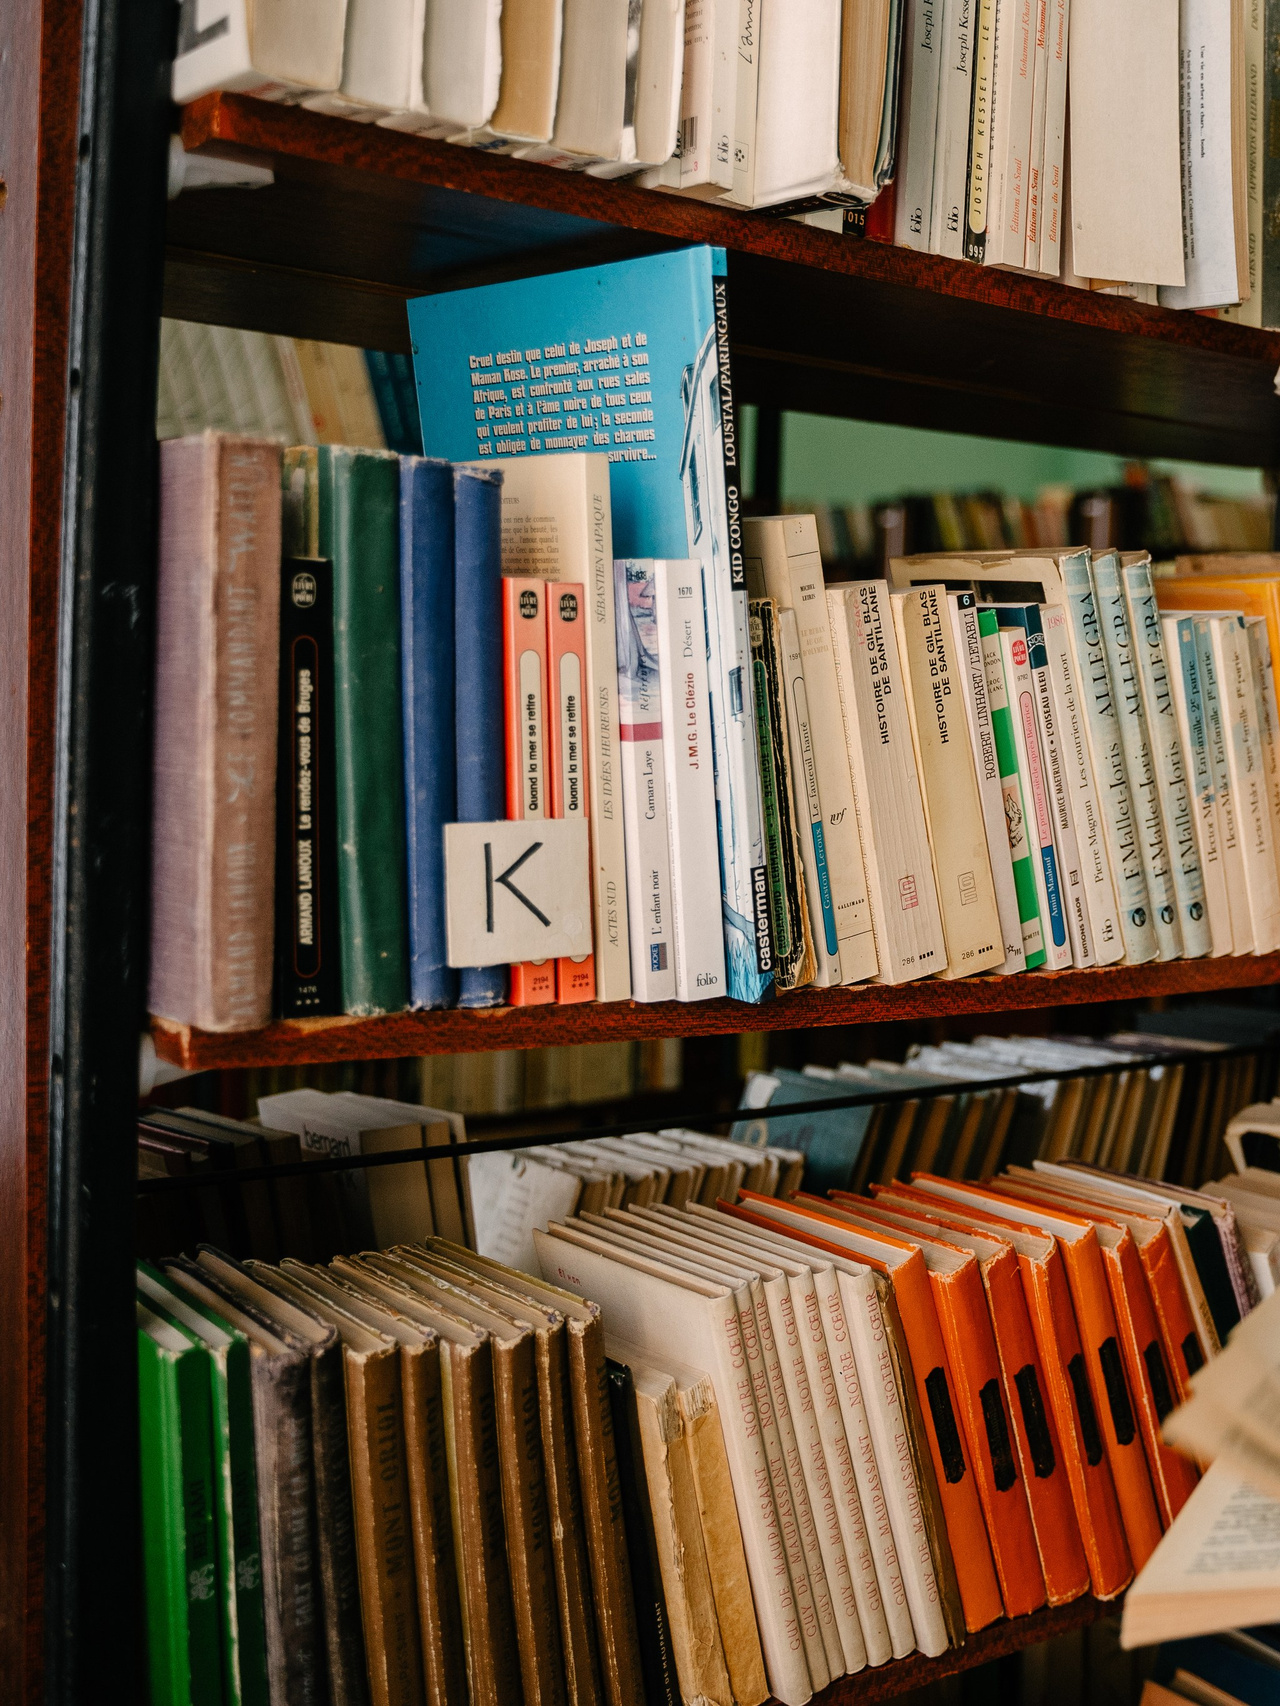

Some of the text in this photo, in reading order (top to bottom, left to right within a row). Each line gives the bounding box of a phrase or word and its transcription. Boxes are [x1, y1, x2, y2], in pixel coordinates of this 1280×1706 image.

[921, 10, 934, 53] Joseph
[956, 33, 969, 76] Joseph
[973, 25, 990, 215] JOSEPH KESSEL LE
[1010, 27, 1029, 234] Éditions du Seuil Mohammed
[910, 208, 923, 234] folio
[947, 206, 959, 233] folio
[470, 332, 647, 370] Cruel destin que celui de Joseph et de
[471, 371, 501, 387] Maman
[504, 368, 528, 383] Rose.
[530, 364, 541, 379] Le
[544, 359, 580, 379] premier,
[632, 352, 648, 367] son
[473, 387, 507, 406] Afrique,
[512, 384, 525, 399] est
[577, 378, 593, 392] aux
[598, 375, 620, 391] rues
[625, 371, 650, 387] sales
[475, 406, 485, 421] de
[489, 402, 512, 419] Paris
[516, 401, 524, 416] et
[564, 395, 587, 412] noire
[591, 393, 602, 409] de
[606, 392, 625, 407] tous
[630, 390, 652, 405] ceux
[477, 407, 653, 440] qui veulent profiter de lui la seconde
[479, 442, 492, 456] est
[530, 436, 540, 452] de
[545, 433, 588, 451] monnayer
[594, 430, 609, 446] des
[614, 426, 655, 443] charmes
[715, 283, 744, 583] KID CONGO LOUSTAL/PARINGAUX
[593, 494, 606, 624] SÉBASTIEN LAPAQUE
[678, 587, 692, 596] 1670
[962, 595, 970, 605] 6
[682, 620, 693, 658] Désert
[868, 585, 892, 695] DE SANTILLANE
[1079, 591, 1114, 718] ALLEGRA
[859, 588, 890, 744] HISTOIRE DE GIL BLAS
[1037, 671, 1049, 692] BLEU
[1186, 661, 1199, 695] partie
[685, 673, 696, 709] Clézio
[973, 673, 990, 727] LINHART
[687, 712, 697, 726] Le
[1041, 696, 1056, 736] L'OISEAU
[526, 694, 538, 811] Quand la mer se retire
[599, 687, 613, 820] LES IDÉES HEUREUSES
[982, 731, 997, 780] ROBERT
[1022, 702, 1048, 840] Le premier siècle après Béatrice
[643, 751, 656, 820] Camara Laye
[1059, 652, 1115, 942] folio Pierre Magnan Les courriers de la mort
[1199, 784, 1212, 819] Malot
[297, 670, 313, 945] ARMAND LANOUX Le rendez-vous de Bruges
[799, 721, 832, 909] Gaston Leroux Le fauteuil hanté
[830, 807, 847, 826] nrf
[1057, 796, 1069, 830] MAURICE
[768, 834, 781, 885] LEHMANN
[1203, 822, 1217, 863] Hector
[484, 842, 552, 933] K
[650, 870, 660, 890] noir
[1043, 855, 1059, 917] Amin Maalouf
[607, 882, 618, 947] ACTES SUD
[650, 893, 661, 924] enfant
[754, 868, 771, 971] casterman
[837, 898, 865, 910] GALLIMARD
[1074, 897, 1089, 958] ÉDITIONS LABOR
[572, 973, 589, 982] 2194
[651, 944, 660, 970] POCKET
[696, 973, 718, 987] folio
[865, 1292, 939, 1604] GUY DE MAUPASSANT NOTRE CŒUR
[723, 1315, 802, 1651] GUY DE MAUPASSANT NOTRE CŒUR
